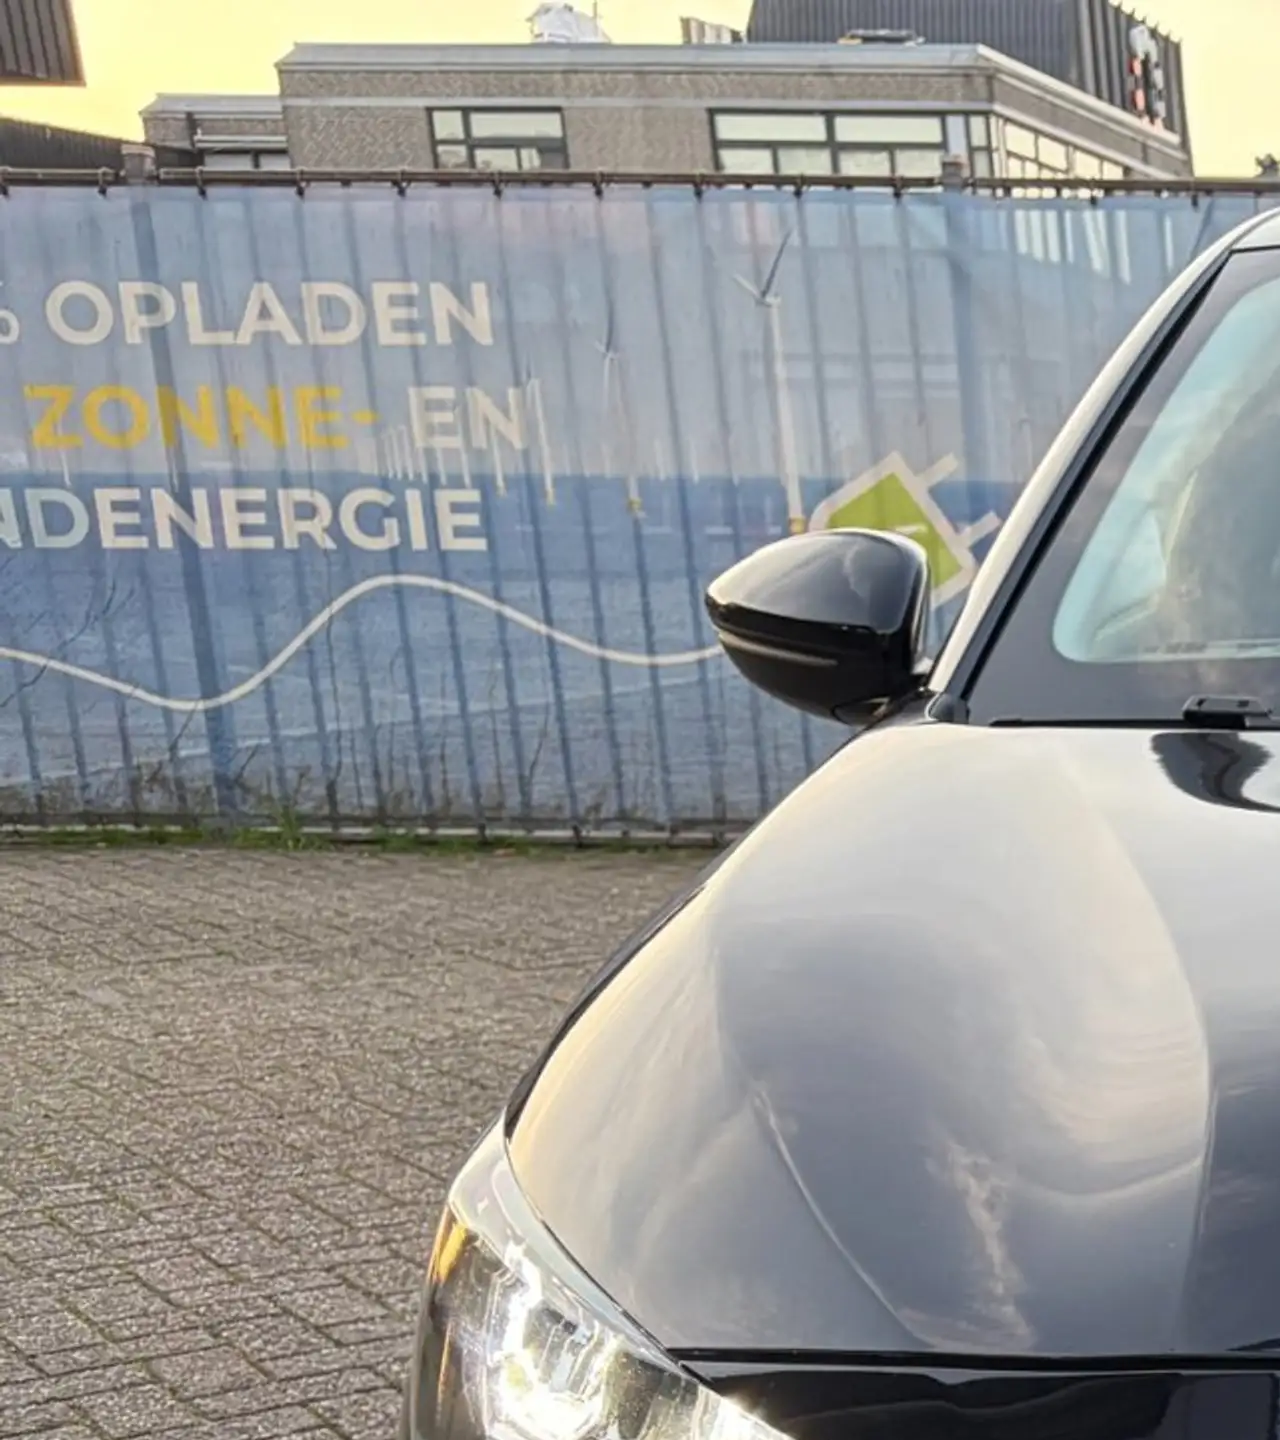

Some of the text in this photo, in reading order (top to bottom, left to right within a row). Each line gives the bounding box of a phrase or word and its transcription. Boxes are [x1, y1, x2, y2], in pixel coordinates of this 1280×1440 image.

[44, 281, 494, 346] OPLADEN
[23, 385, 527, 450] ZONNE- EN
